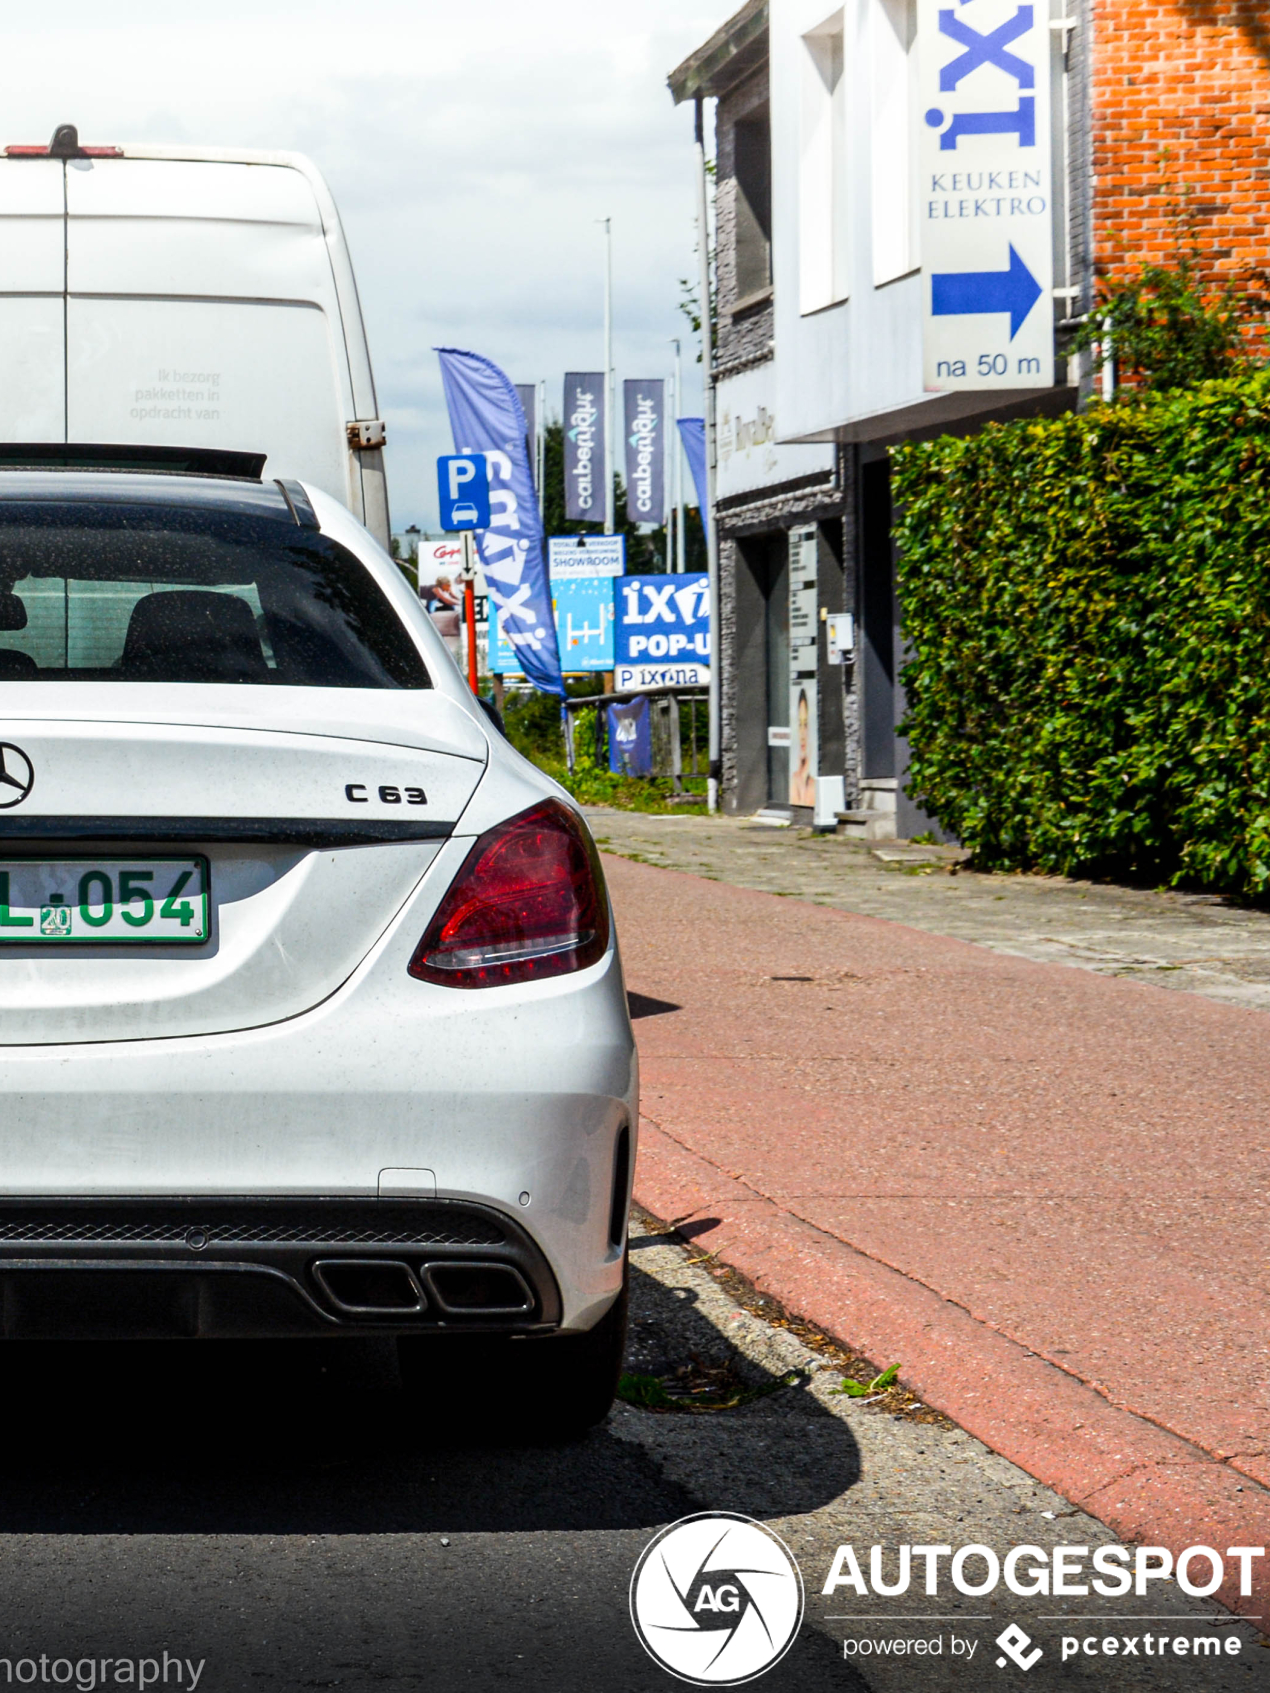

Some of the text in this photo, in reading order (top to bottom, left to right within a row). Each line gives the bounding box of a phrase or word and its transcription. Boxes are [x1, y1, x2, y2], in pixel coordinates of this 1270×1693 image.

[925, 0, 1035, 150] ix
[931, 170, 1041, 192] KEUKEN
[928, 196, 1046, 219] ELEKTRO
[937, 353, 1040, 378] na 50 m
[158, 368, 220, 387] Ik bezorg
[135, 387, 220, 403] pakketten in
[130, 405, 220, 421] opdracht van
[448, 459, 476, 499] P
[553, 556, 620, 567] SHOWROOM
[629, 632, 710, 657] POP-U
[345, 784, 428, 805] C 63
[41, 906, 71, 929] 20
